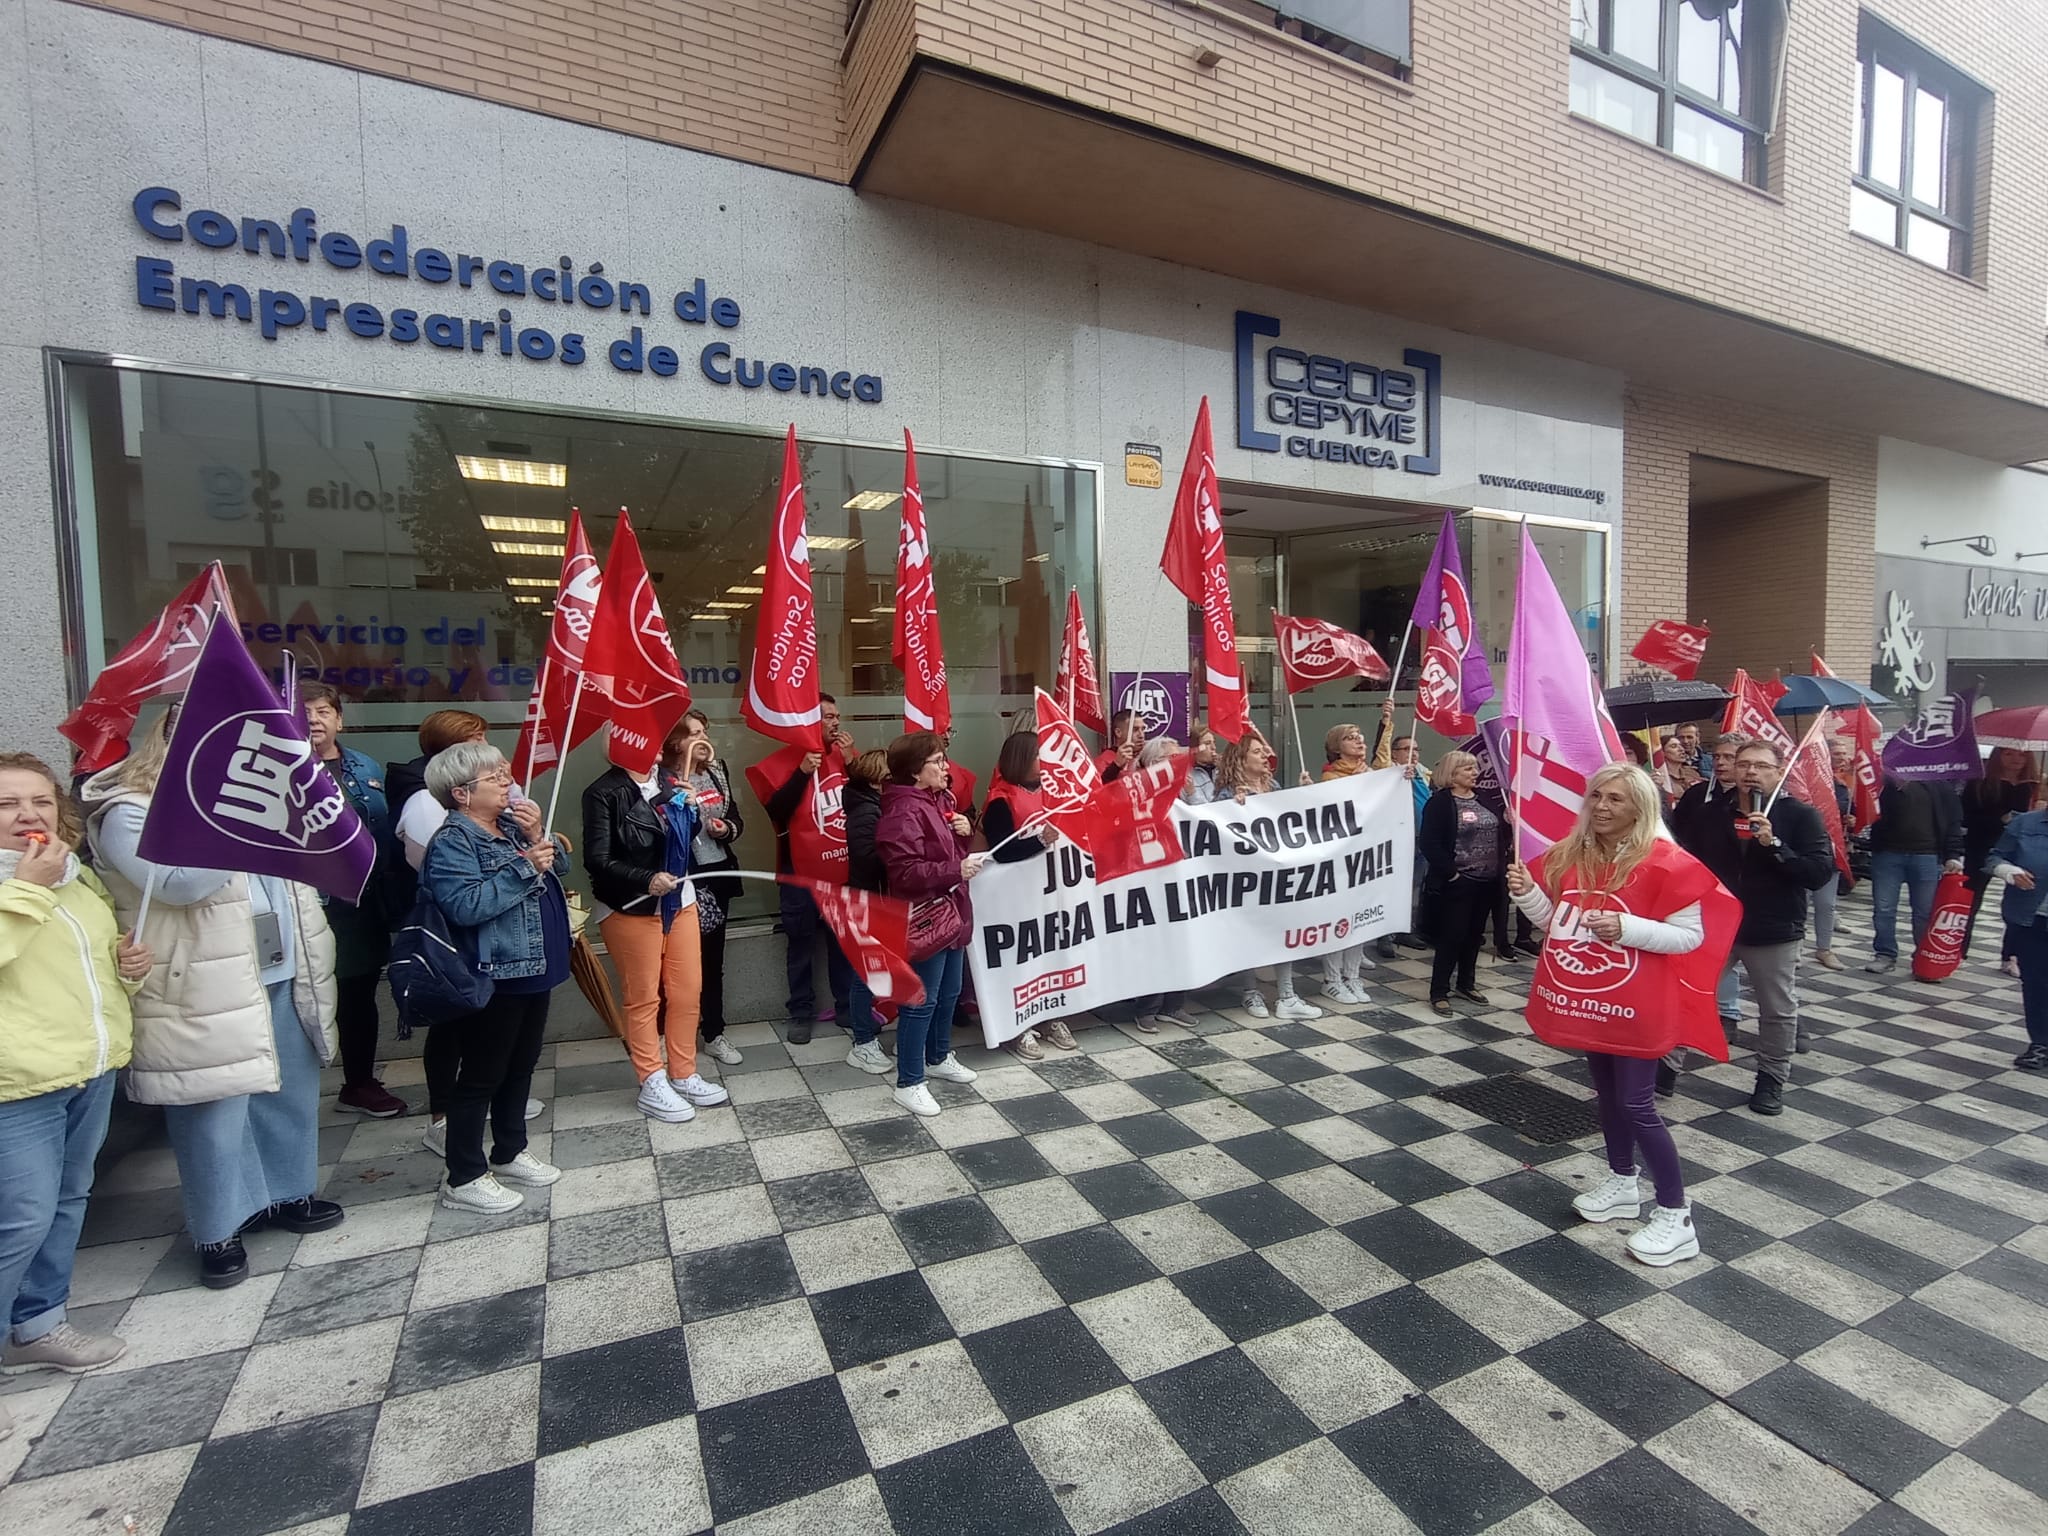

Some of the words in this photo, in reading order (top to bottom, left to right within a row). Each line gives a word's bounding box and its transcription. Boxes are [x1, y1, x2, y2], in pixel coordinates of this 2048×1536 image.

[133, 187, 651, 315] Confederación
[673, 279, 741, 328] de
[136, 256, 586, 365] Empresarios
[609, 327, 679, 376] de
[700, 341, 883, 403] Cuenca
[1268, 392, 1416, 444] CEPYME
[1287, 436, 1399, 469] CUENCA
[1478, 473, 1605, 505] www.ceoecuenca.org
[1964, 567, 2027, 618] banak
[240, 615, 390, 646] servicio
[424, 617, 486, 647] del
[446, 663, 475, 695] y
[1125, 689, 1166, 714] UGT
[1743, 700, 1793, 757] COO
[213, 720, 312, 830] UGT
[1039, 729, 1097, 790] UGT
[1896, 761, 1969, 775] www.ugt.es
[1227, 800, 1363, 856] SOCIAL
[983, 901, 1095, 969] PARA
[1103, 886, 1156, 934] LA
[1164, 860, 1336, 922] LIMPIEZA
[1345, 840, 1393, 889] YA!!
[1935, 910, 1969, 930] UG
[1285, 922, 1332, 949] UGT
[1354, 904, 1384, 924] FeSMC
[1015, 993, 1066, 1026] hábitat
[1537, 984, 1568, 1006] mano
[1570, 1000, 1578, 1008] a
[1581, 998, 1635, 1019] mano
[1555, 1006, 1569, 1016] tus
[1569, 1008, 1608, 1023] derechos
